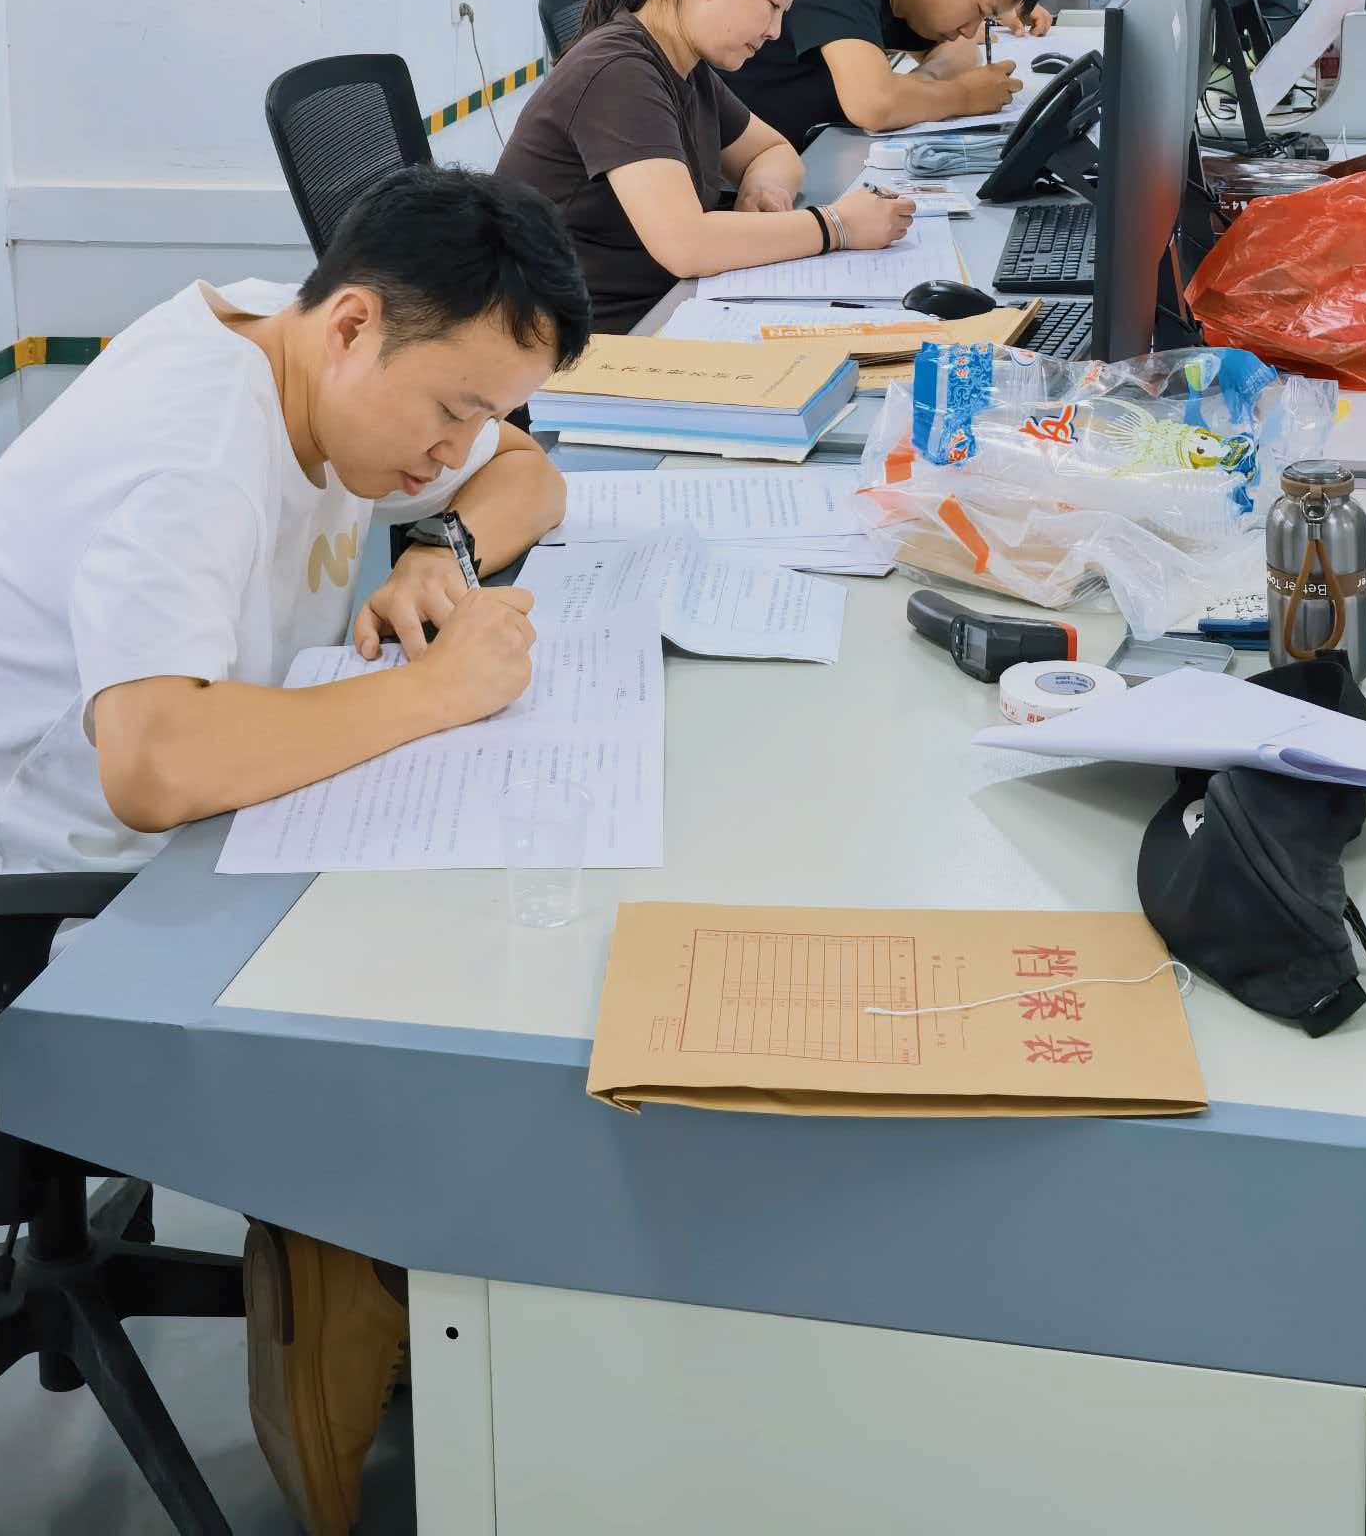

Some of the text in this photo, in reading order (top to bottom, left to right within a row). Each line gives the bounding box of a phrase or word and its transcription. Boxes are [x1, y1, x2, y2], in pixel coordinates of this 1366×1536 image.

[1283, 578, 1328, 596] Beter
[1012, 943, 1093, 1064] 档案袋
